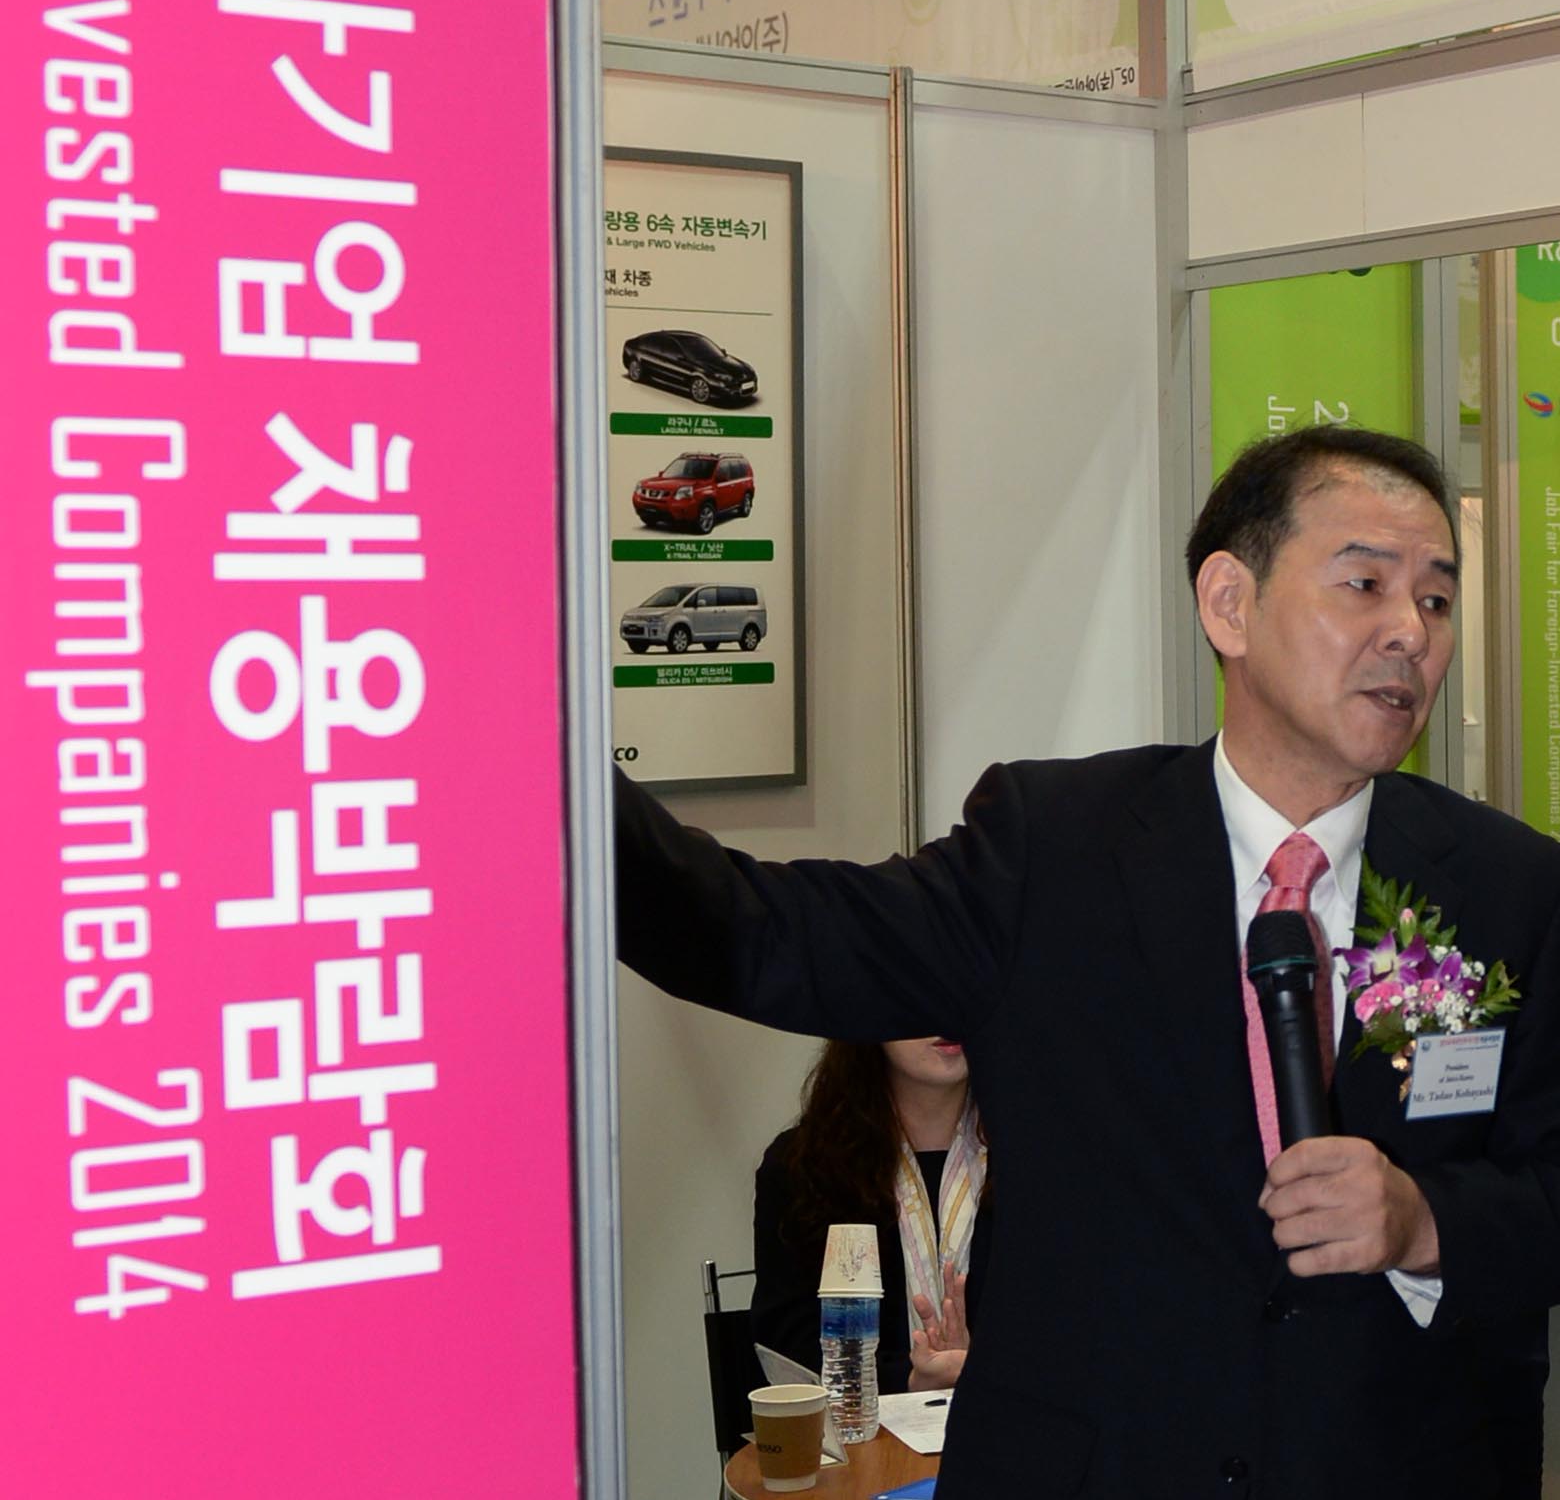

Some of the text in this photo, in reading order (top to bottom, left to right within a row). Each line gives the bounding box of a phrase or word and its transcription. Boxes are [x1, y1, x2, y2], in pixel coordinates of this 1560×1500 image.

[616, 237, 645, 250] Large
[647, 238, 672, 249] FWD
[673, 240, 716, 252] Vehicles
[646, 213, 676, 235] 6속
[681, 216, 768, 241] 자동변속기
[604, 287, 640, 298] ehicles
[622, 269, 653, 288] 차종
[1267, 395, 1297, 442] Jo
[25, 416, 187, 1028] Companies
[209, 412, 442, 1299] 채용박람회
[67, 1068, 207, 1319] 2014
